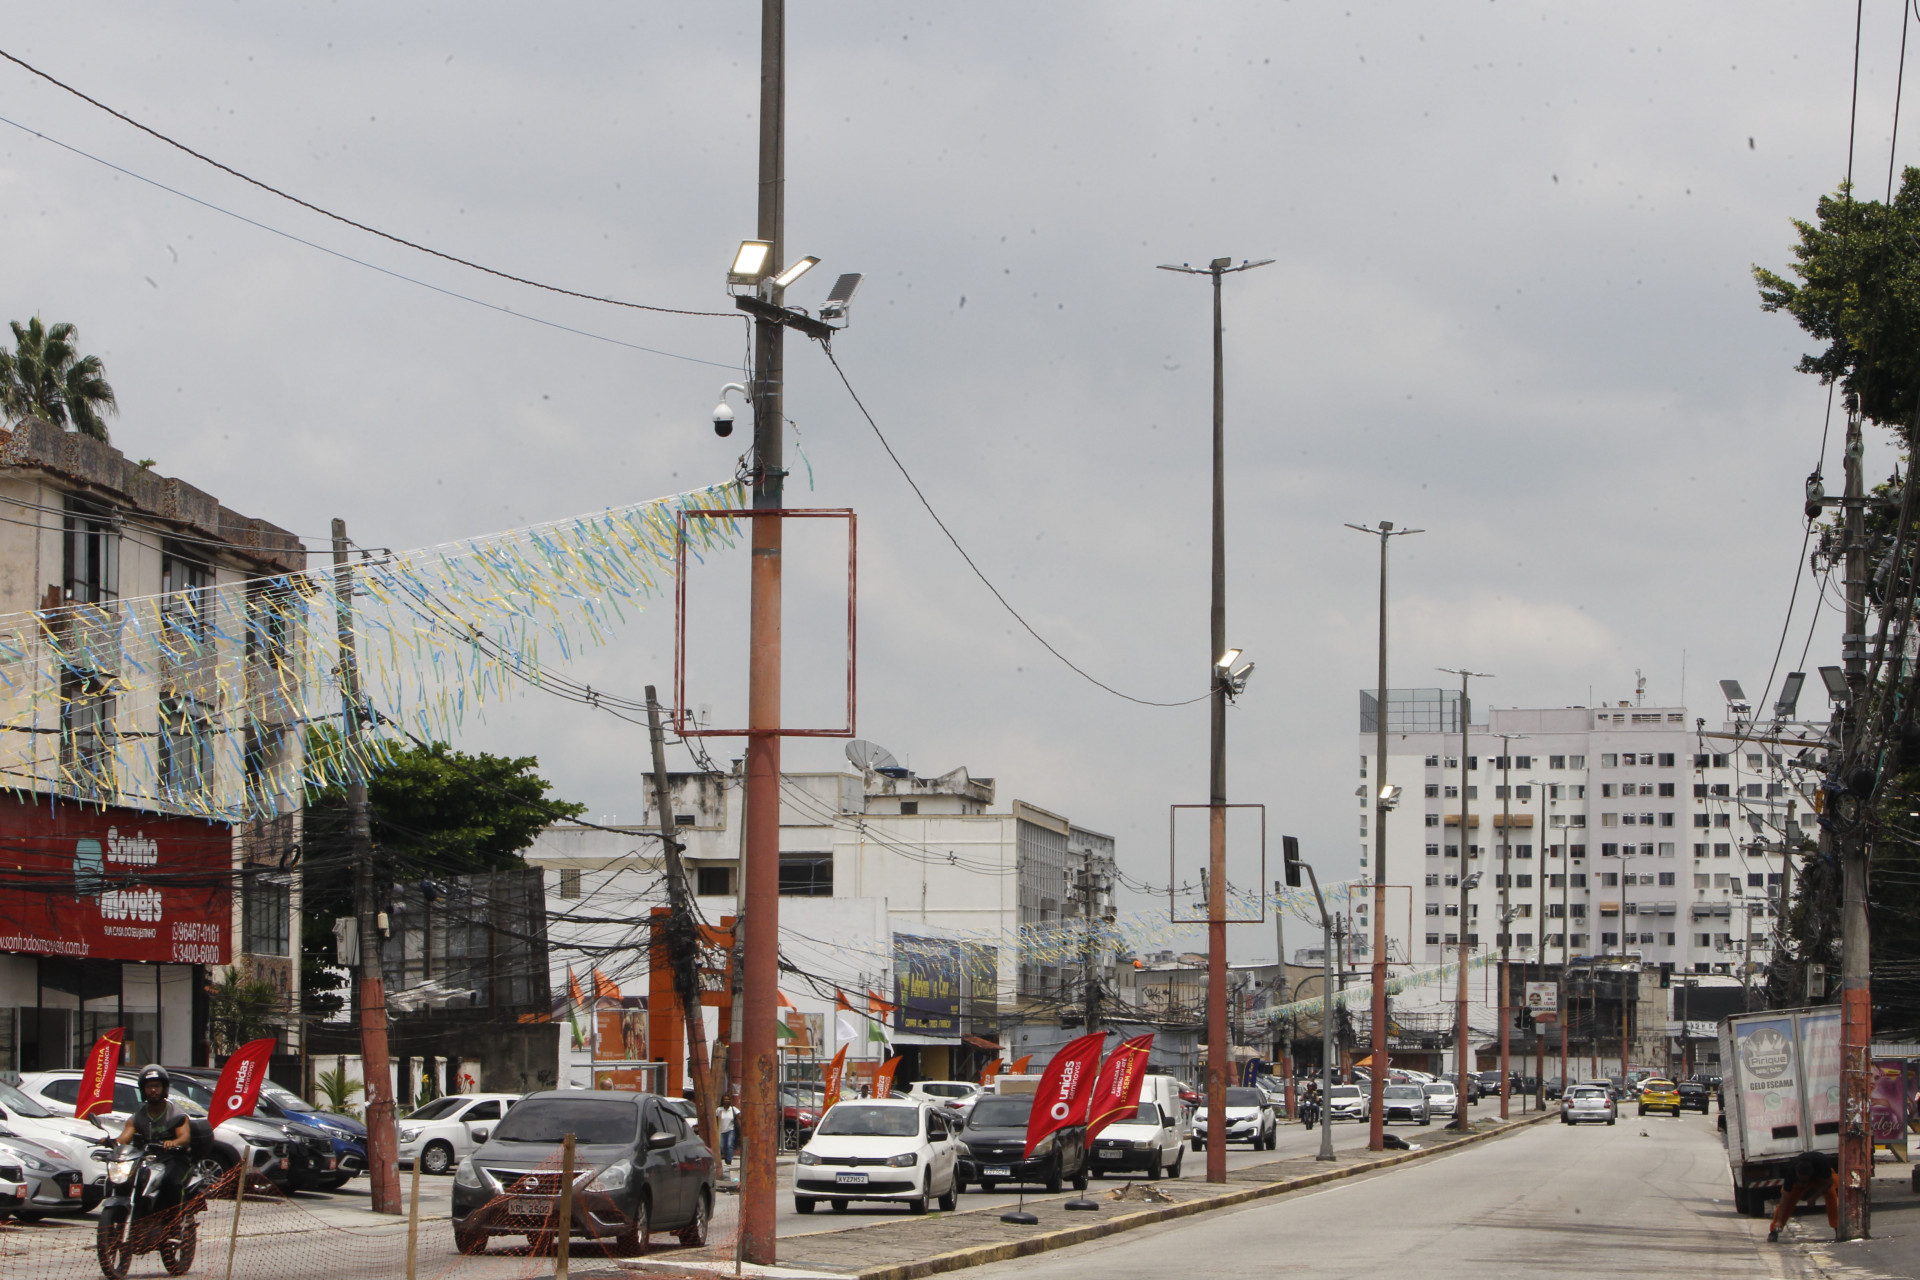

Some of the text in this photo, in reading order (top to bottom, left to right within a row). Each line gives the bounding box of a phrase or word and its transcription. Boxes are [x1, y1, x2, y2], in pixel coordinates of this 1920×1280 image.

[107, 825, 158, 867] Sonho
[178, 922, 220, 942] 96467-0161
[178, 943, 220, 963] 3400-6000
[1126, 1053, 1135, 1074] JUROS
[1751, 1055, 1787, 1066] Pirique
[234, 1060, 250, 1093] unidas
[243, 1061, 255, 1094] seminovos
[1059, 1060, 1075, 1100] unidas
[1069, 1061, 1081, 1100] seminovos
[1123, 1075, 1131, 1090] SEM
[1750, 1078, 1794, 1091] GELO ESCAMA
